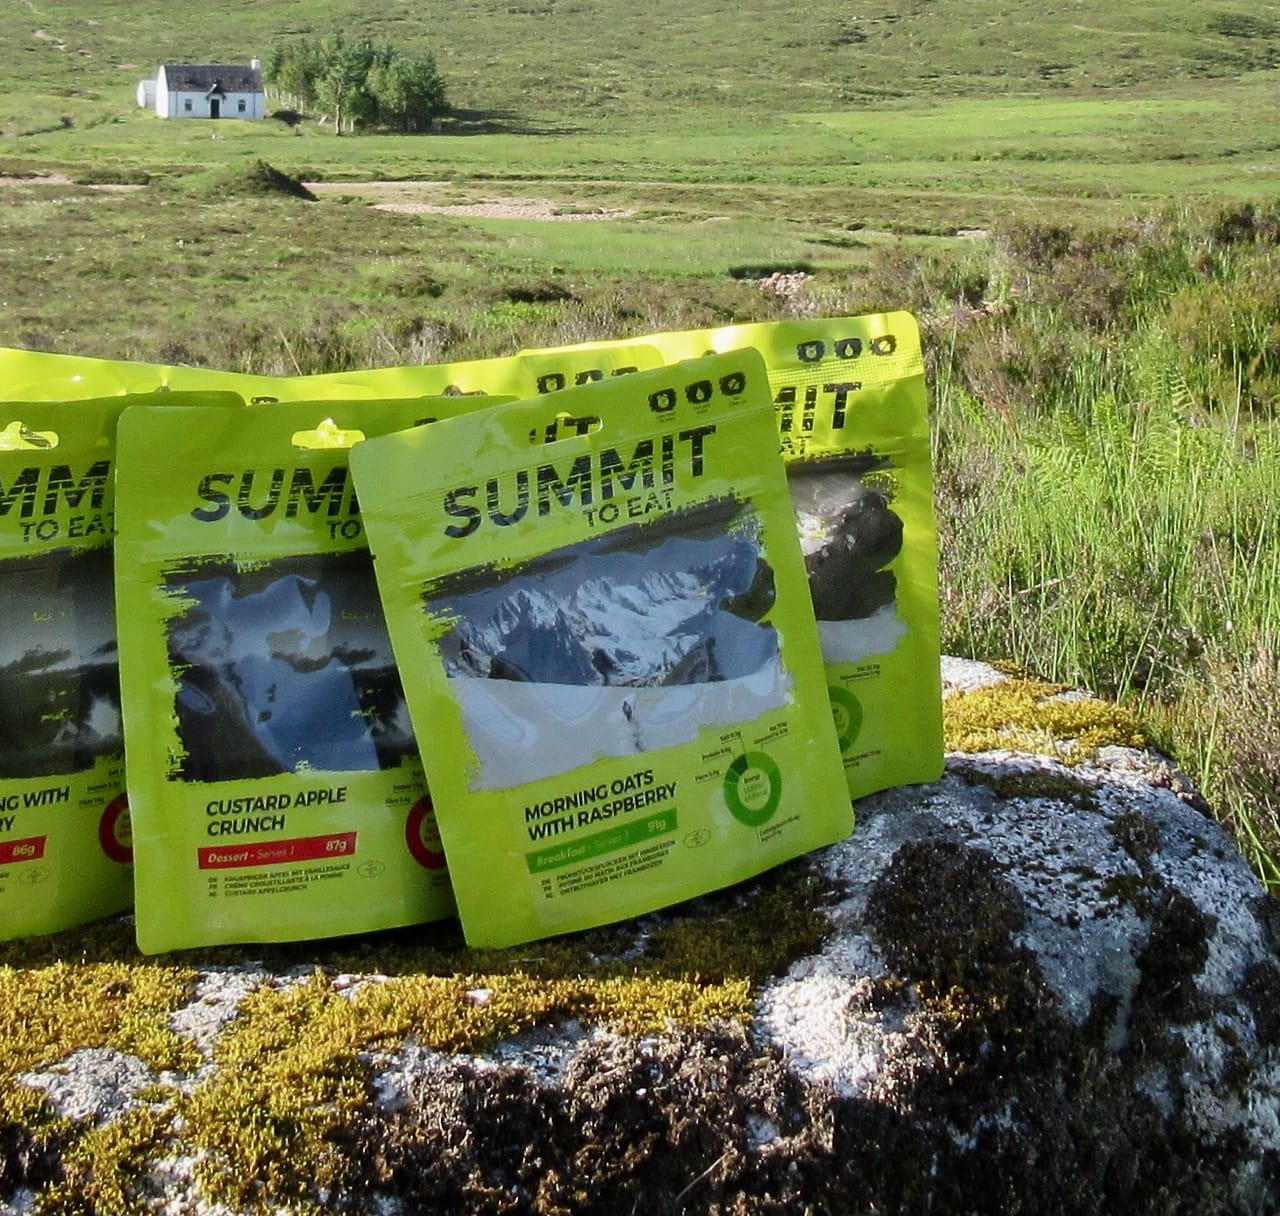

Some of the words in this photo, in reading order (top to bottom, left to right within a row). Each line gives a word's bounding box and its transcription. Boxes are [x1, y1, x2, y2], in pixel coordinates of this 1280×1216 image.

[443, 424, 716, 538] SUMMIT
[582, 503, 619, 527] TO
[626, 488, 674, 518] EAT
[20, 519, 60, 542] TO
[326, 519, 362, 540] TO
[23, 786, 69, 809] WITH
[206, 794, 291, 817] CUSTARD
[294, 787, 347, 808] APPLE
[525, 784, 608, 822] MORNING
[611, 769, 654, 795] OATS
[528, 814, 574, 841] WITH
[578, 782, 677, 826] RASPBERRY
[207, 815, 285, 836] CRUNCH
[647, 819, 666, 833] 91g
[12, 844, 36, 857] 86g
[326, 839, 347, 852] 87g
[536, 846, 587, 866] Breakfast
[208, 851, 249, 864] Dessert
